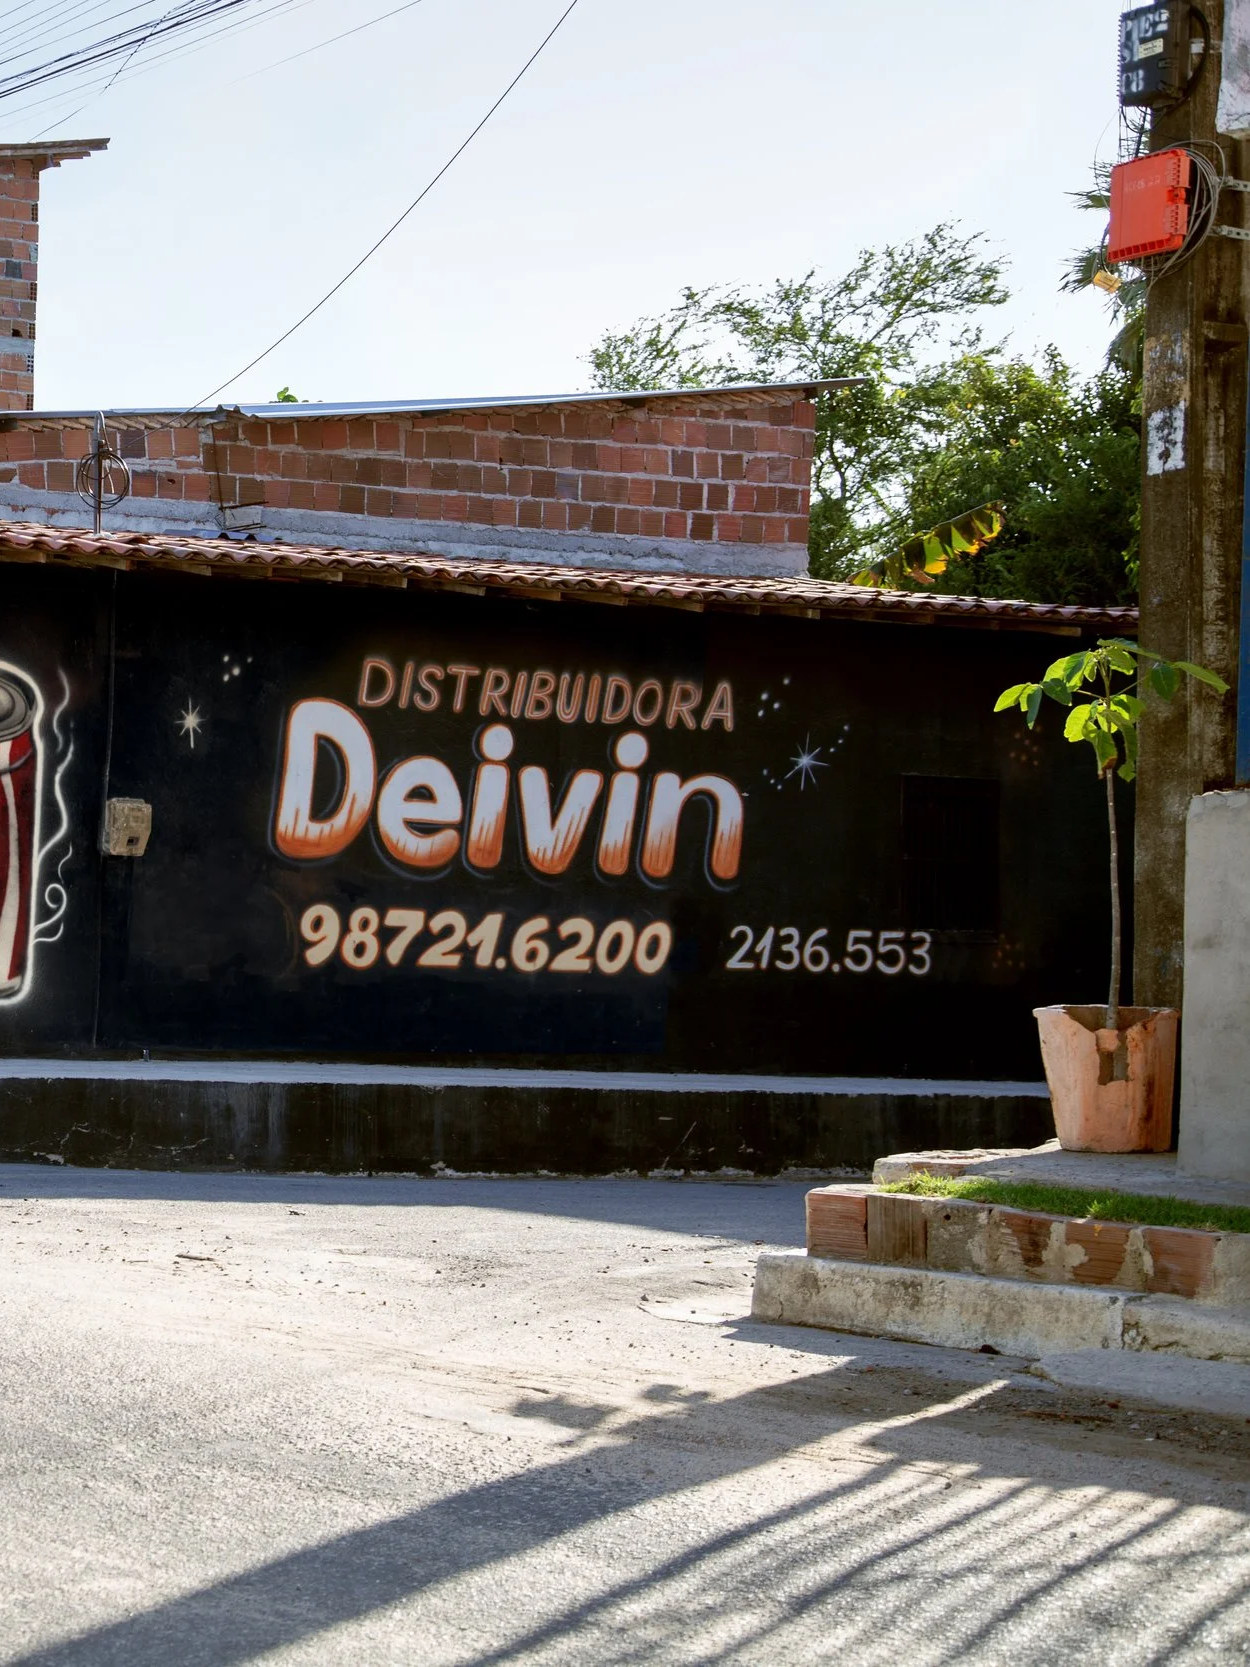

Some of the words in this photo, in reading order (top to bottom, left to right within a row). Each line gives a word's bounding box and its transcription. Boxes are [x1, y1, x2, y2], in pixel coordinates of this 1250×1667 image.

[356, 656, 735, 732] DISTRIBUIDORA
[272, 697, 745, 881] Deivin
[298, 903, 673, 974] 98721.6200
[725, 925, 933, 975] 2136.553
